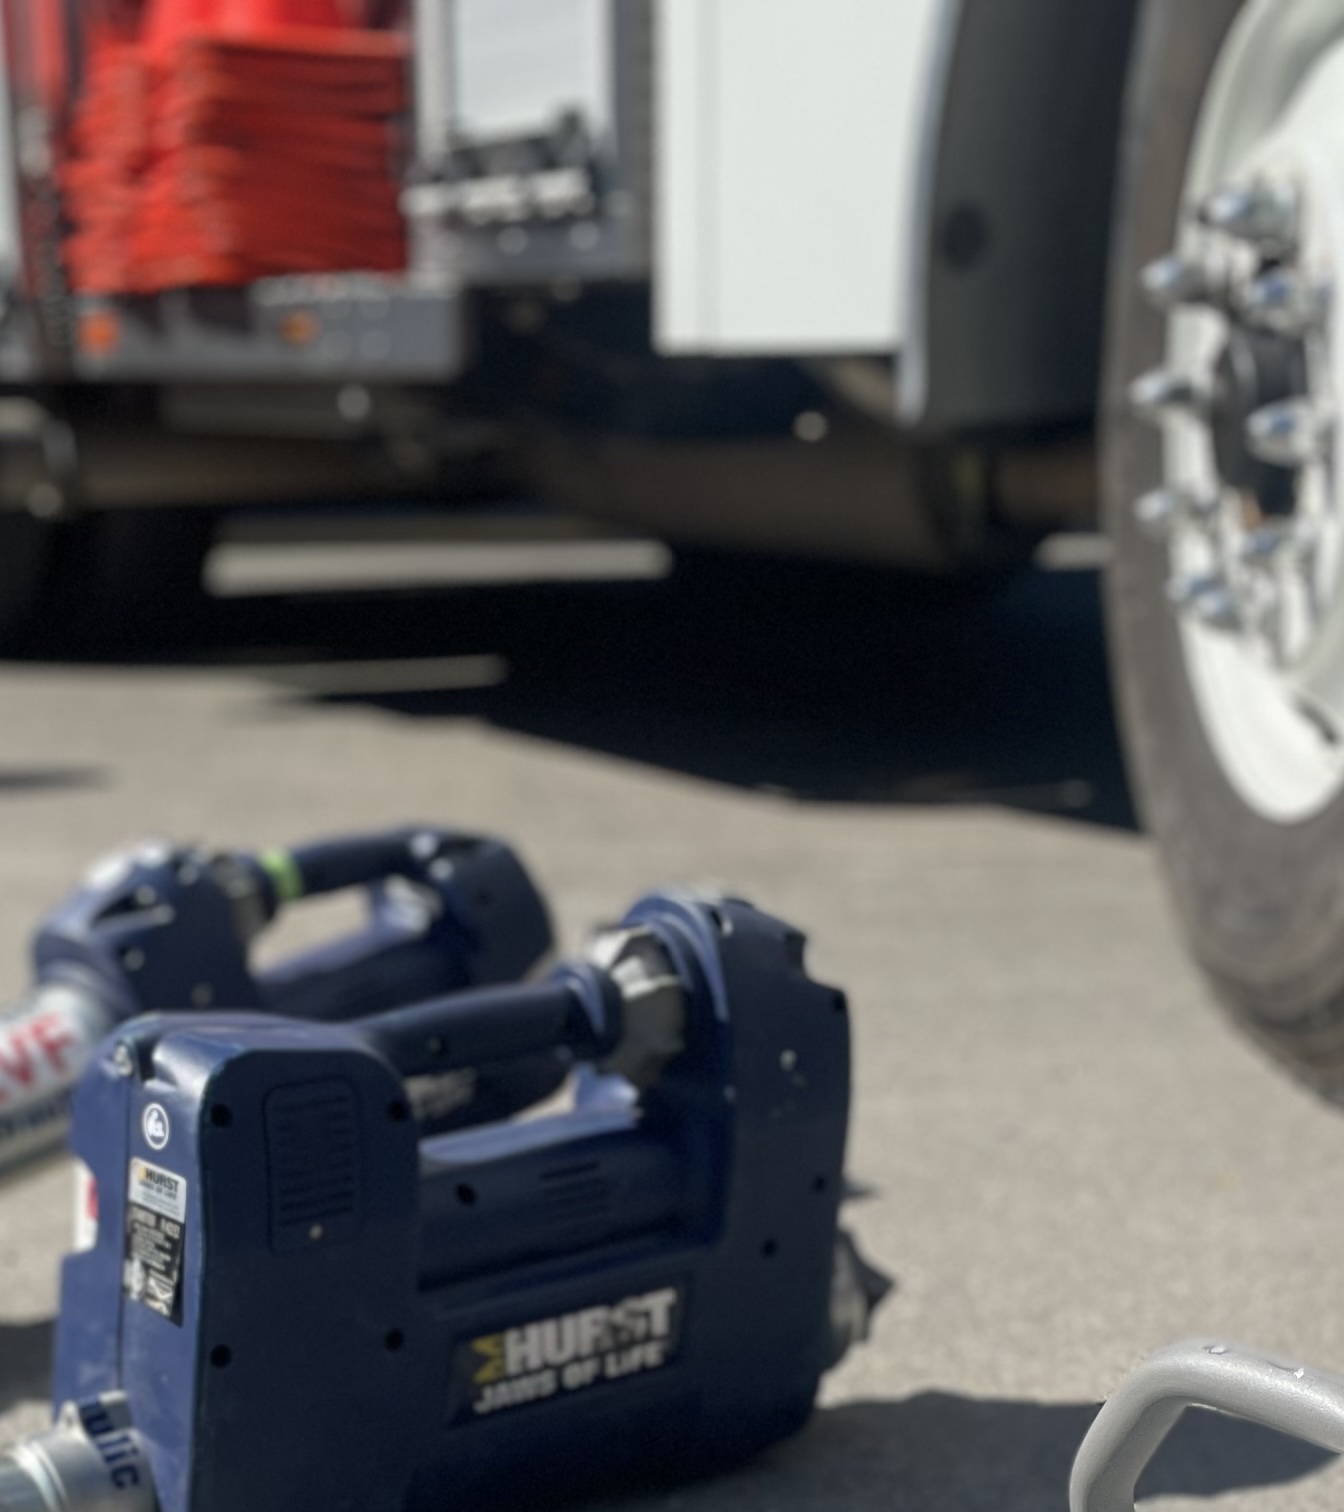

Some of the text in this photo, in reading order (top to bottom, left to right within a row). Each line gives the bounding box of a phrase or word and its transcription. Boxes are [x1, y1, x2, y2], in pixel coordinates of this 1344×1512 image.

[144, 1167, 180, 1193] HURST
[506, 1287, 677, 1376] HURST
[473, 1340, 666, 1414] JAWS OF LIFE
